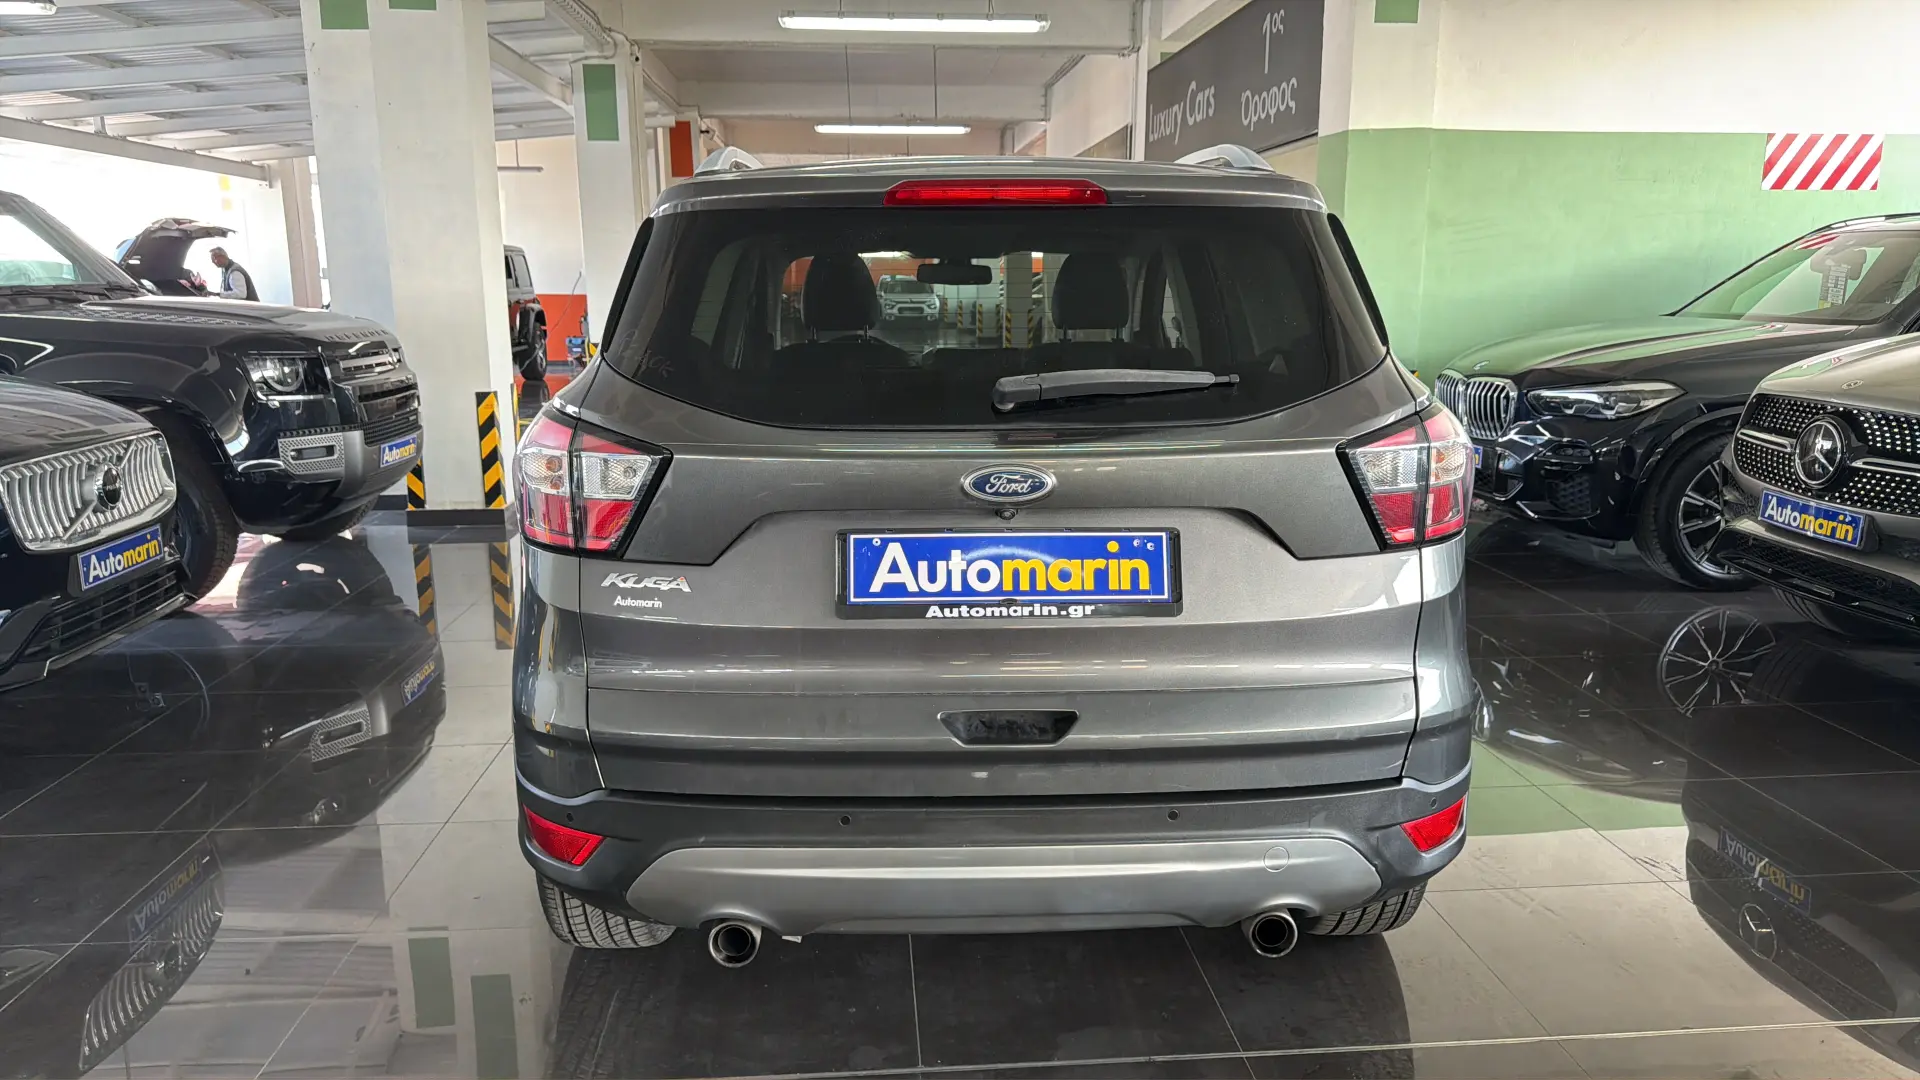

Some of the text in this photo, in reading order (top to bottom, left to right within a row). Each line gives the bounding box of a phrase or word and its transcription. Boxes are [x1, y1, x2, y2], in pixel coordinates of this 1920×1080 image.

[1149, 80, 1215, 145] Luxury Cars
[1241, 77, 1297, 132] Όροφος
[383, 440, 416, 464] Automarin
[985, 473, 1032, 493] Ford
[1764, 496, 1854, 542] Automarin
[88, 534, 159, 583] Automarin
[868, 541, 1150, 592] Automarin
[601, 572, 692, 592] KUGA
[613, 595, 662, 609] Automarin
[925, 603, 1096, 618] Automarin.gr
